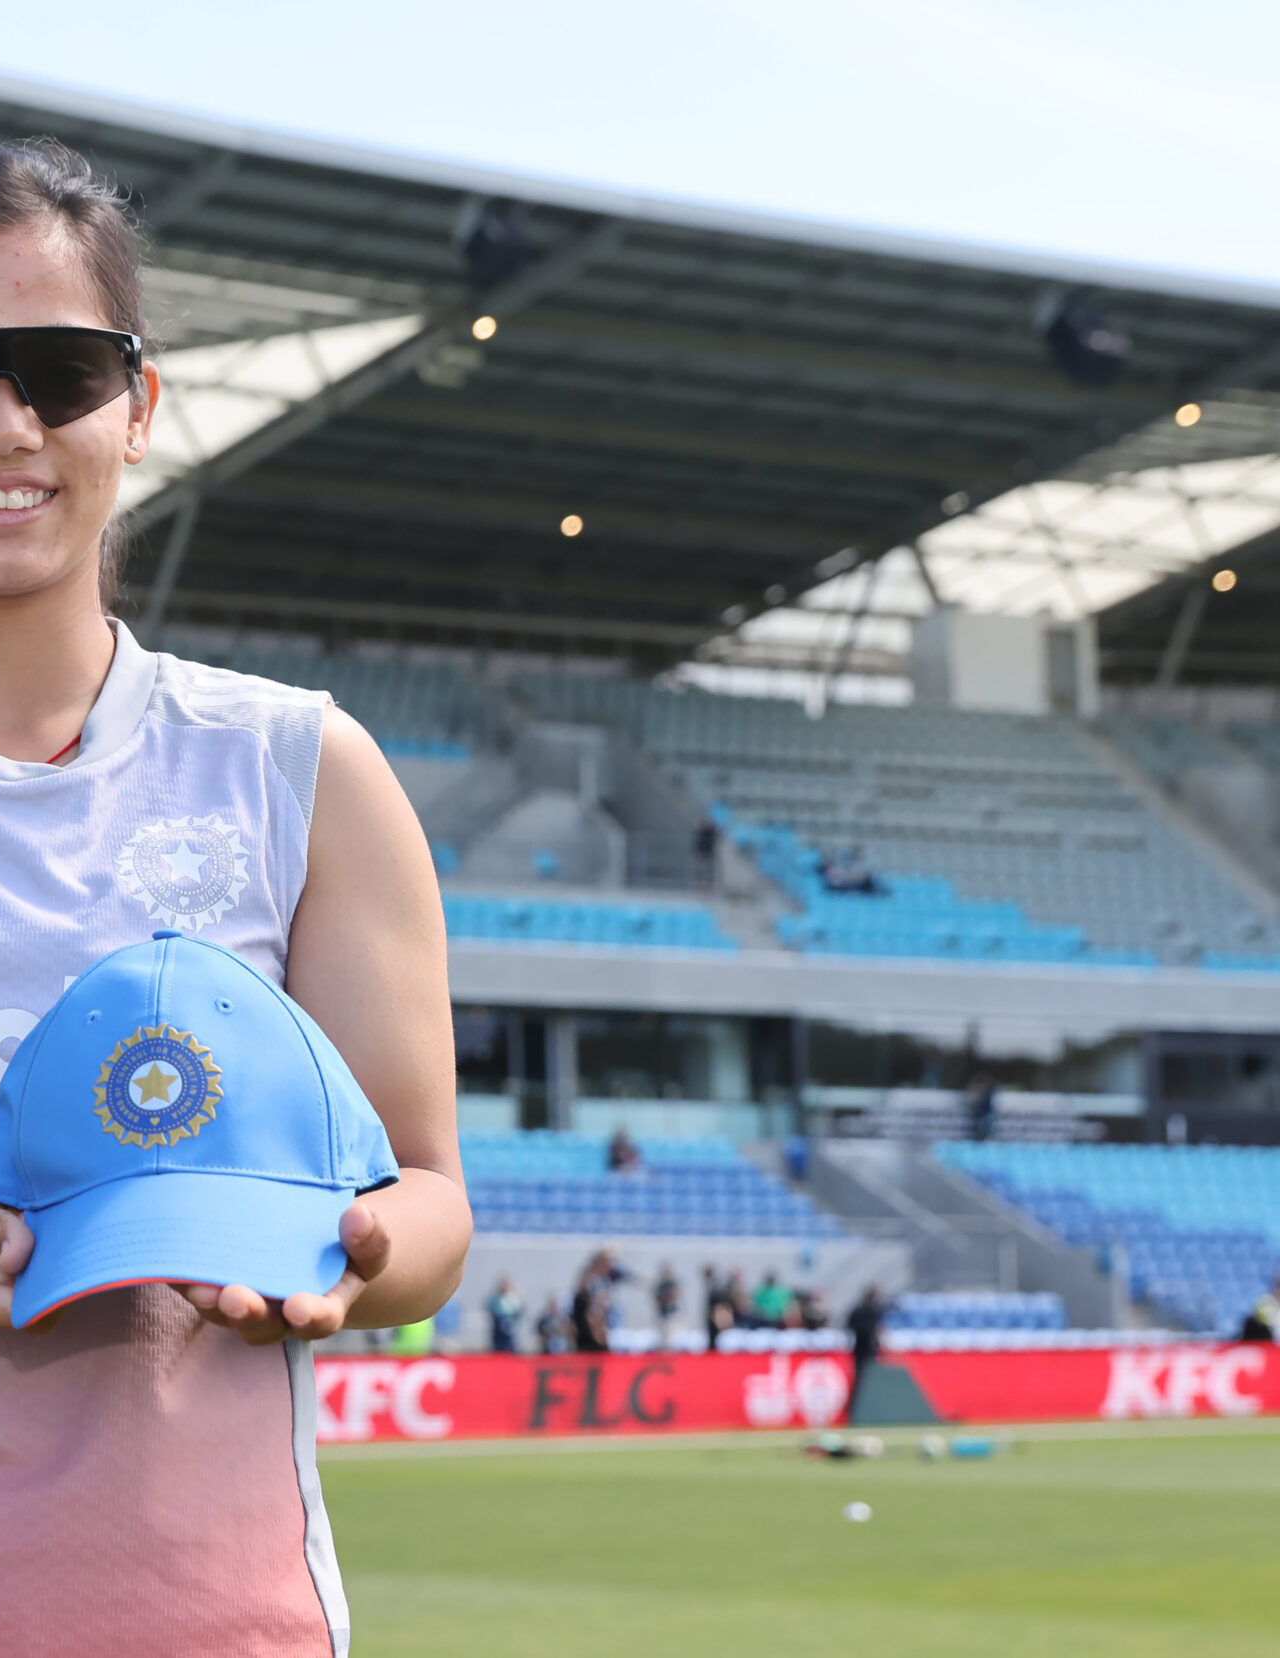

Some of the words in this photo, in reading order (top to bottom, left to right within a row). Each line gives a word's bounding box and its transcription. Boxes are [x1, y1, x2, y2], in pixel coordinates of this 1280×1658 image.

[116, 1049, 148, 1083] CONTROL
[150, 1047, 169, 1056] FOR
[171, 1050, 197, 1082] CRICKET
[171, 1097, 195, 1119] INDIA
[530, 1365, 677, 1428] FLG
[1099, 1346, 1266, 1418] KFC
